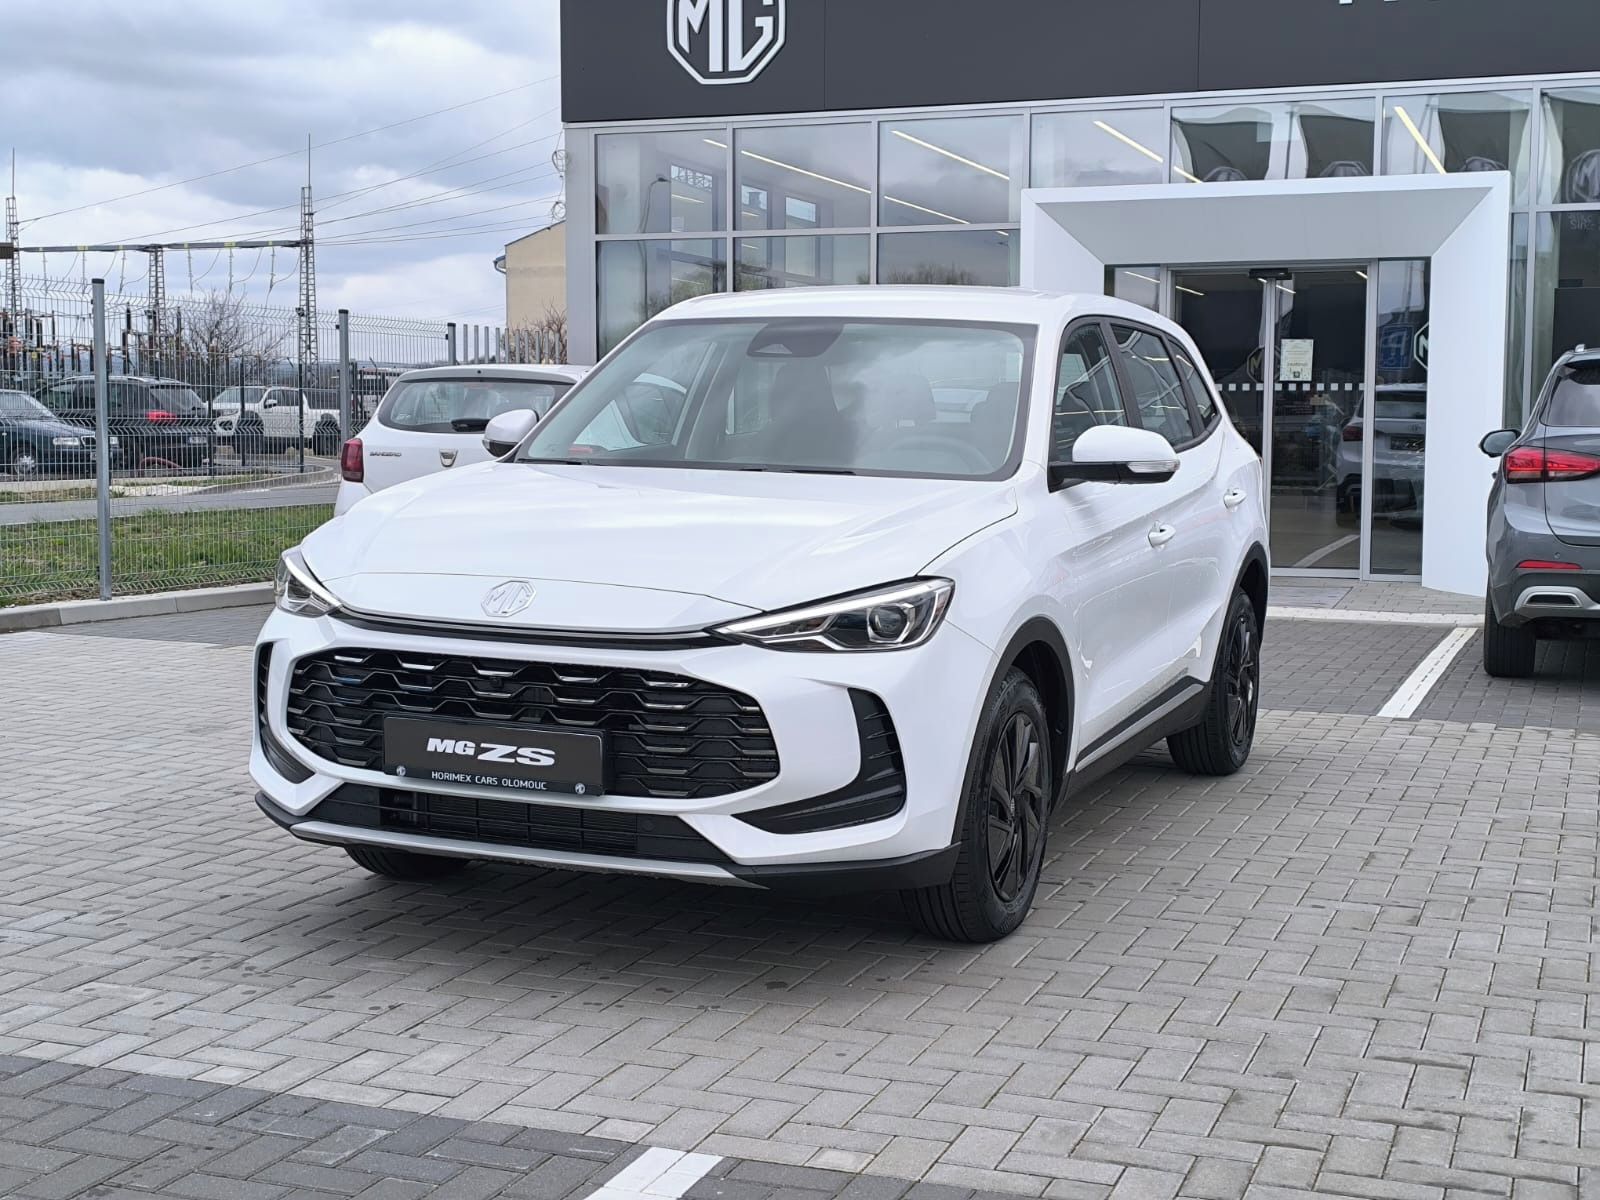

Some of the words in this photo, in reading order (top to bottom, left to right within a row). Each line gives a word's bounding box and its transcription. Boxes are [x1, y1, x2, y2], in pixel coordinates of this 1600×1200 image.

[678, 0, 773, 72] MG
[427, 737, 475, 756] MG
[477, 743, 556, 767] ZS
[431, 771, 472, 783] HORIMEX
[475, 775, 498, 785] CARS
[502, 778, 548, 790] OLOMOUC
